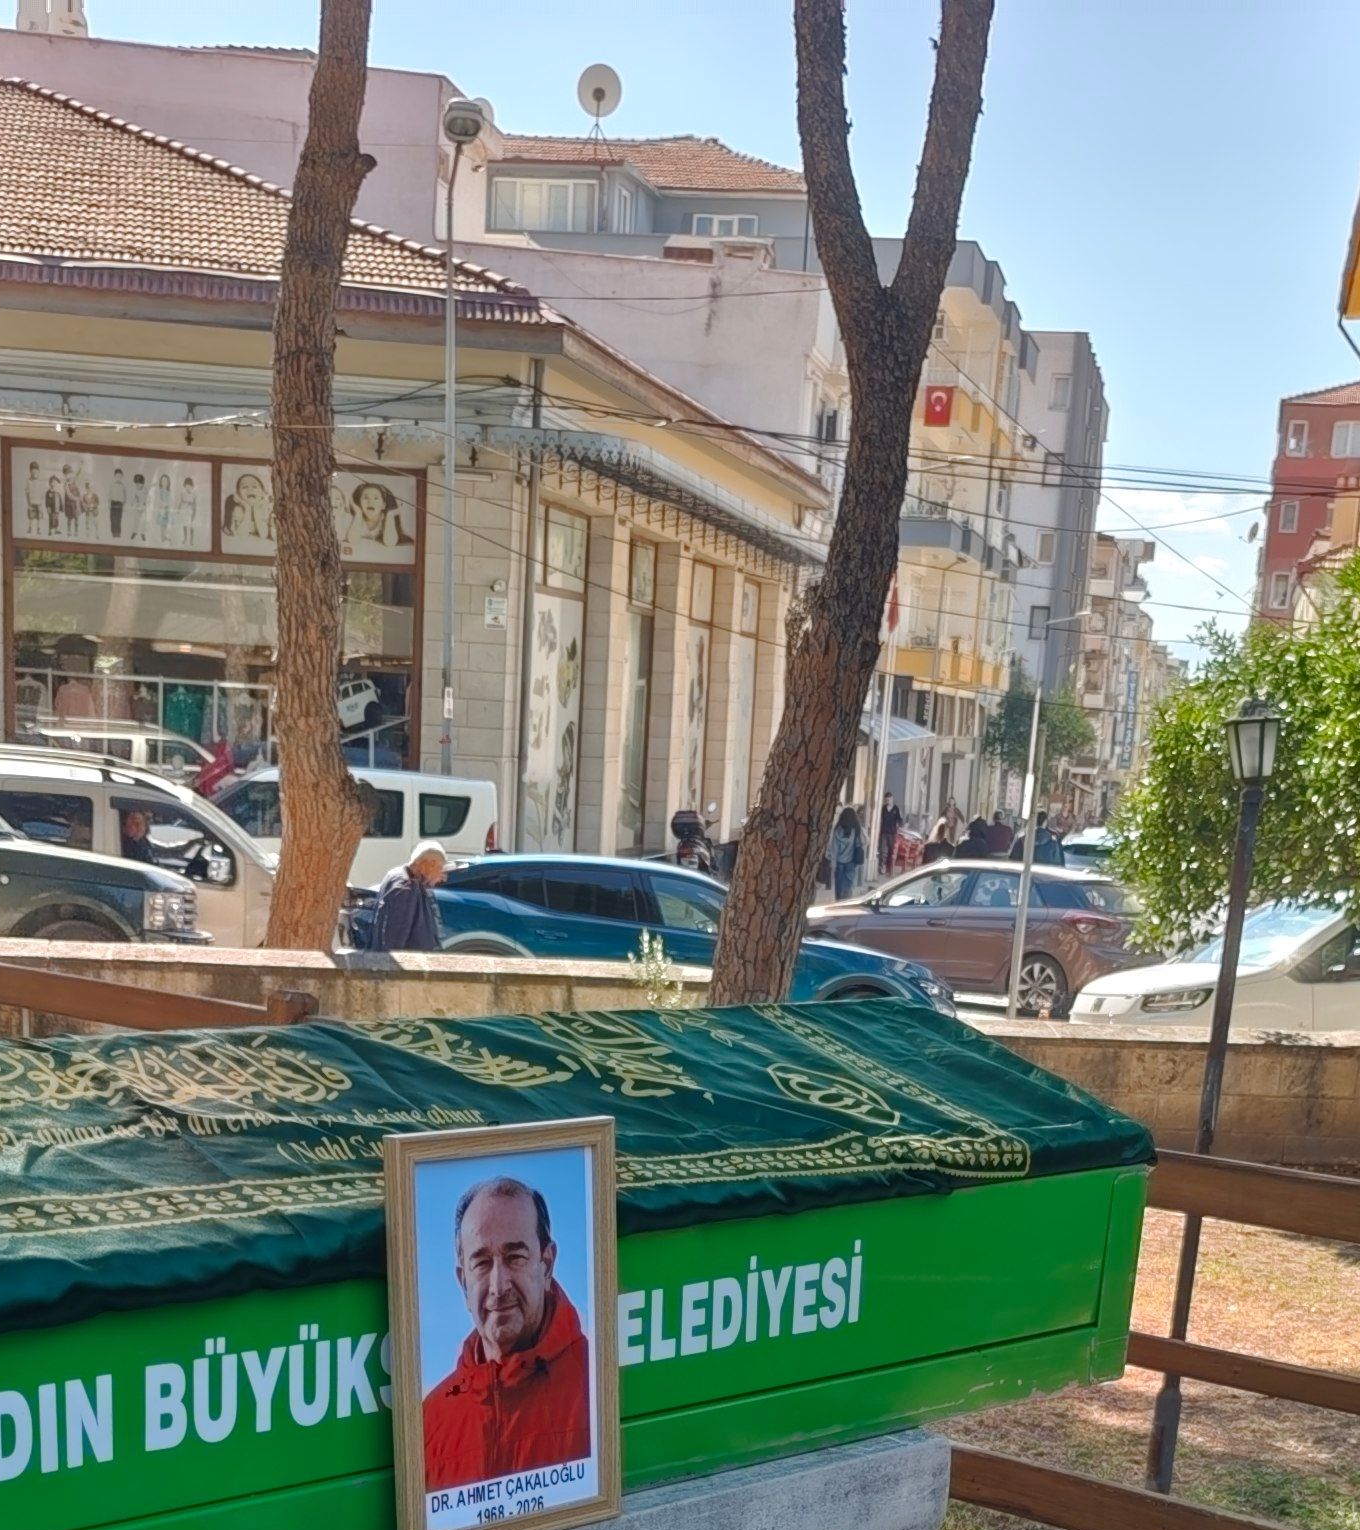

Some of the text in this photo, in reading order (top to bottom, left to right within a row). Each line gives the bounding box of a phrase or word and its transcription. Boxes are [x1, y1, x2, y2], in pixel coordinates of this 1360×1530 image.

[187, 1113, 221, 1136] an
[145, 1323, 393, 1452] BÜYÜK
[618, 1239, 863, 1367] ELEDİYESİ
[431, 1462, 585, 1513] DR. AHMET ÇAKALOĞLU
[476, 1504, 505, 1524] 1968
